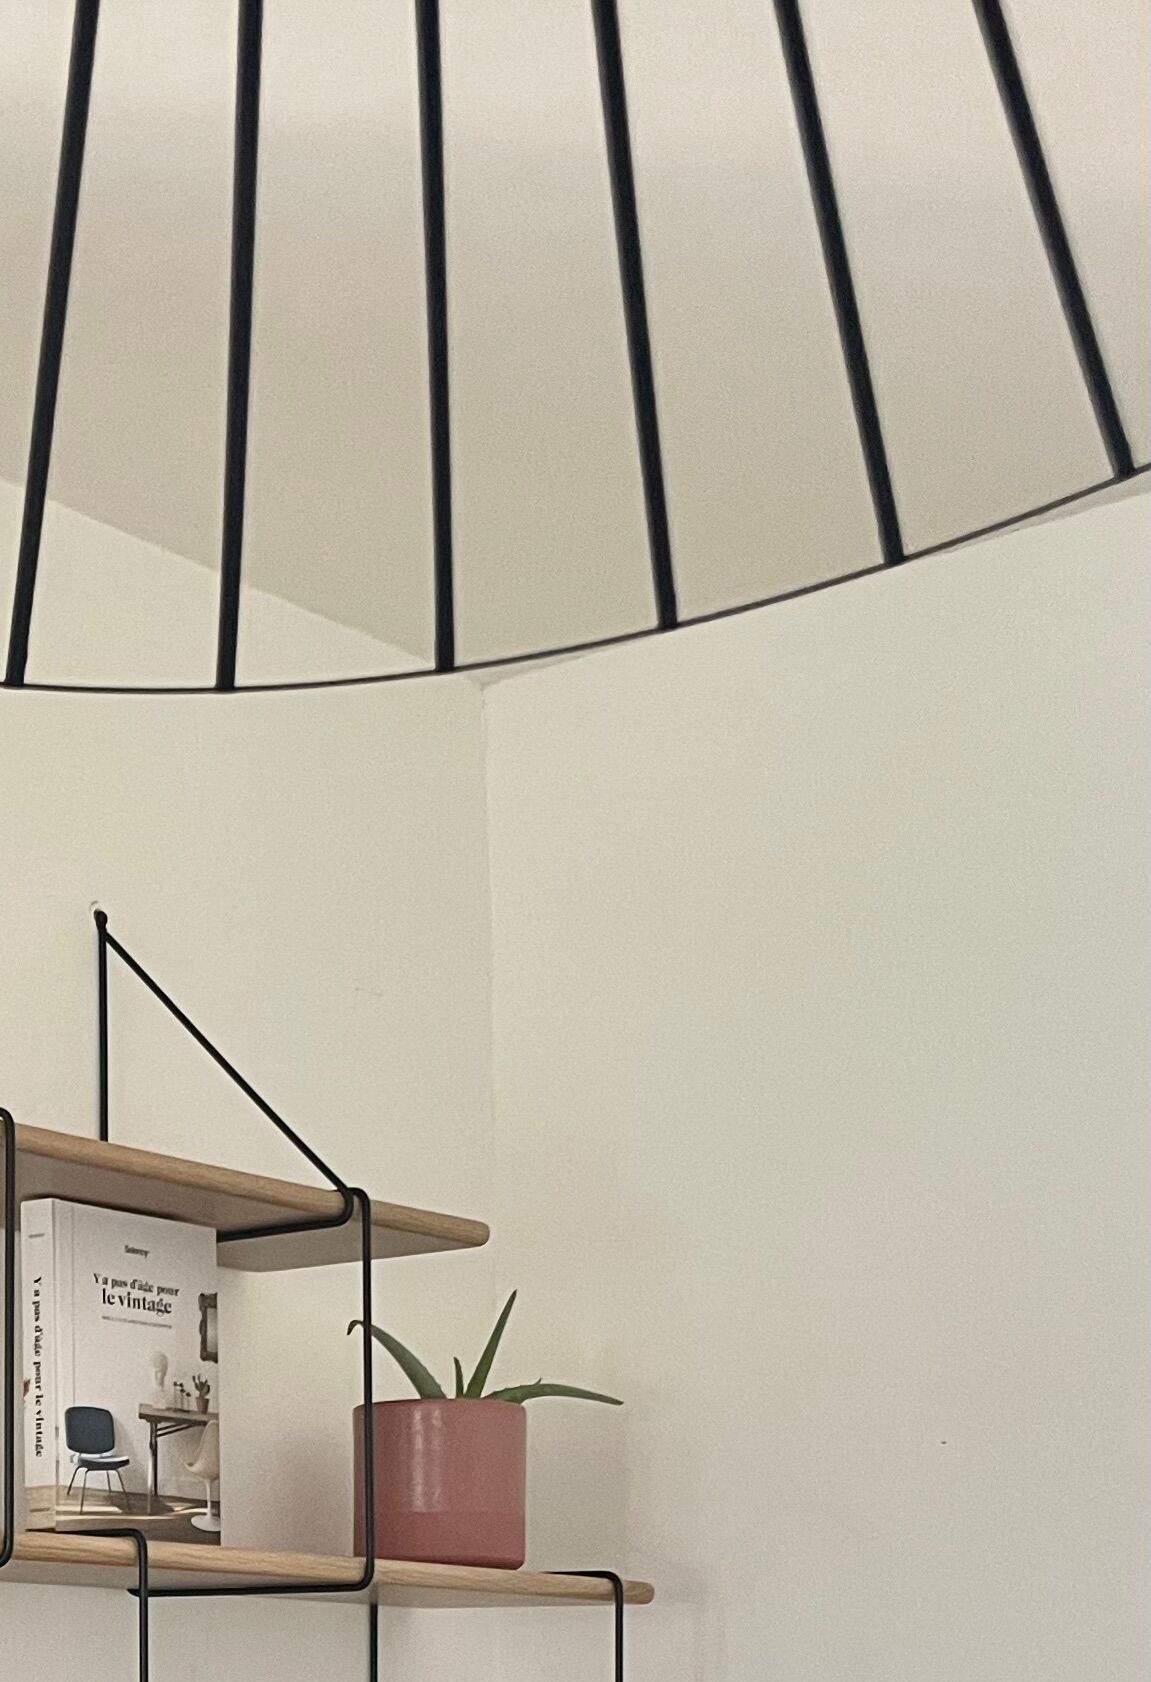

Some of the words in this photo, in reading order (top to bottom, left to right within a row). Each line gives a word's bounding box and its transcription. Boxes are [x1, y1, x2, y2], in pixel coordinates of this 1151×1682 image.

[33, 1276, 43, 1287] Y
[93, 1272, 101, 1284] Y
[102, 1276, 109, 1286] a
[111, 1278, 128, 1290] pas
[156, 1285, 180, 1297] pour
[32, 1300, 41, 1323] pas
[102, 1287, 116, 1306] le
[117, 1291, 173, 1318] vintage
[33, 1361, 42, 1392] pour
[35, 1394, 44, 1407] le
[34, 1409, 45, 1458] vintage
